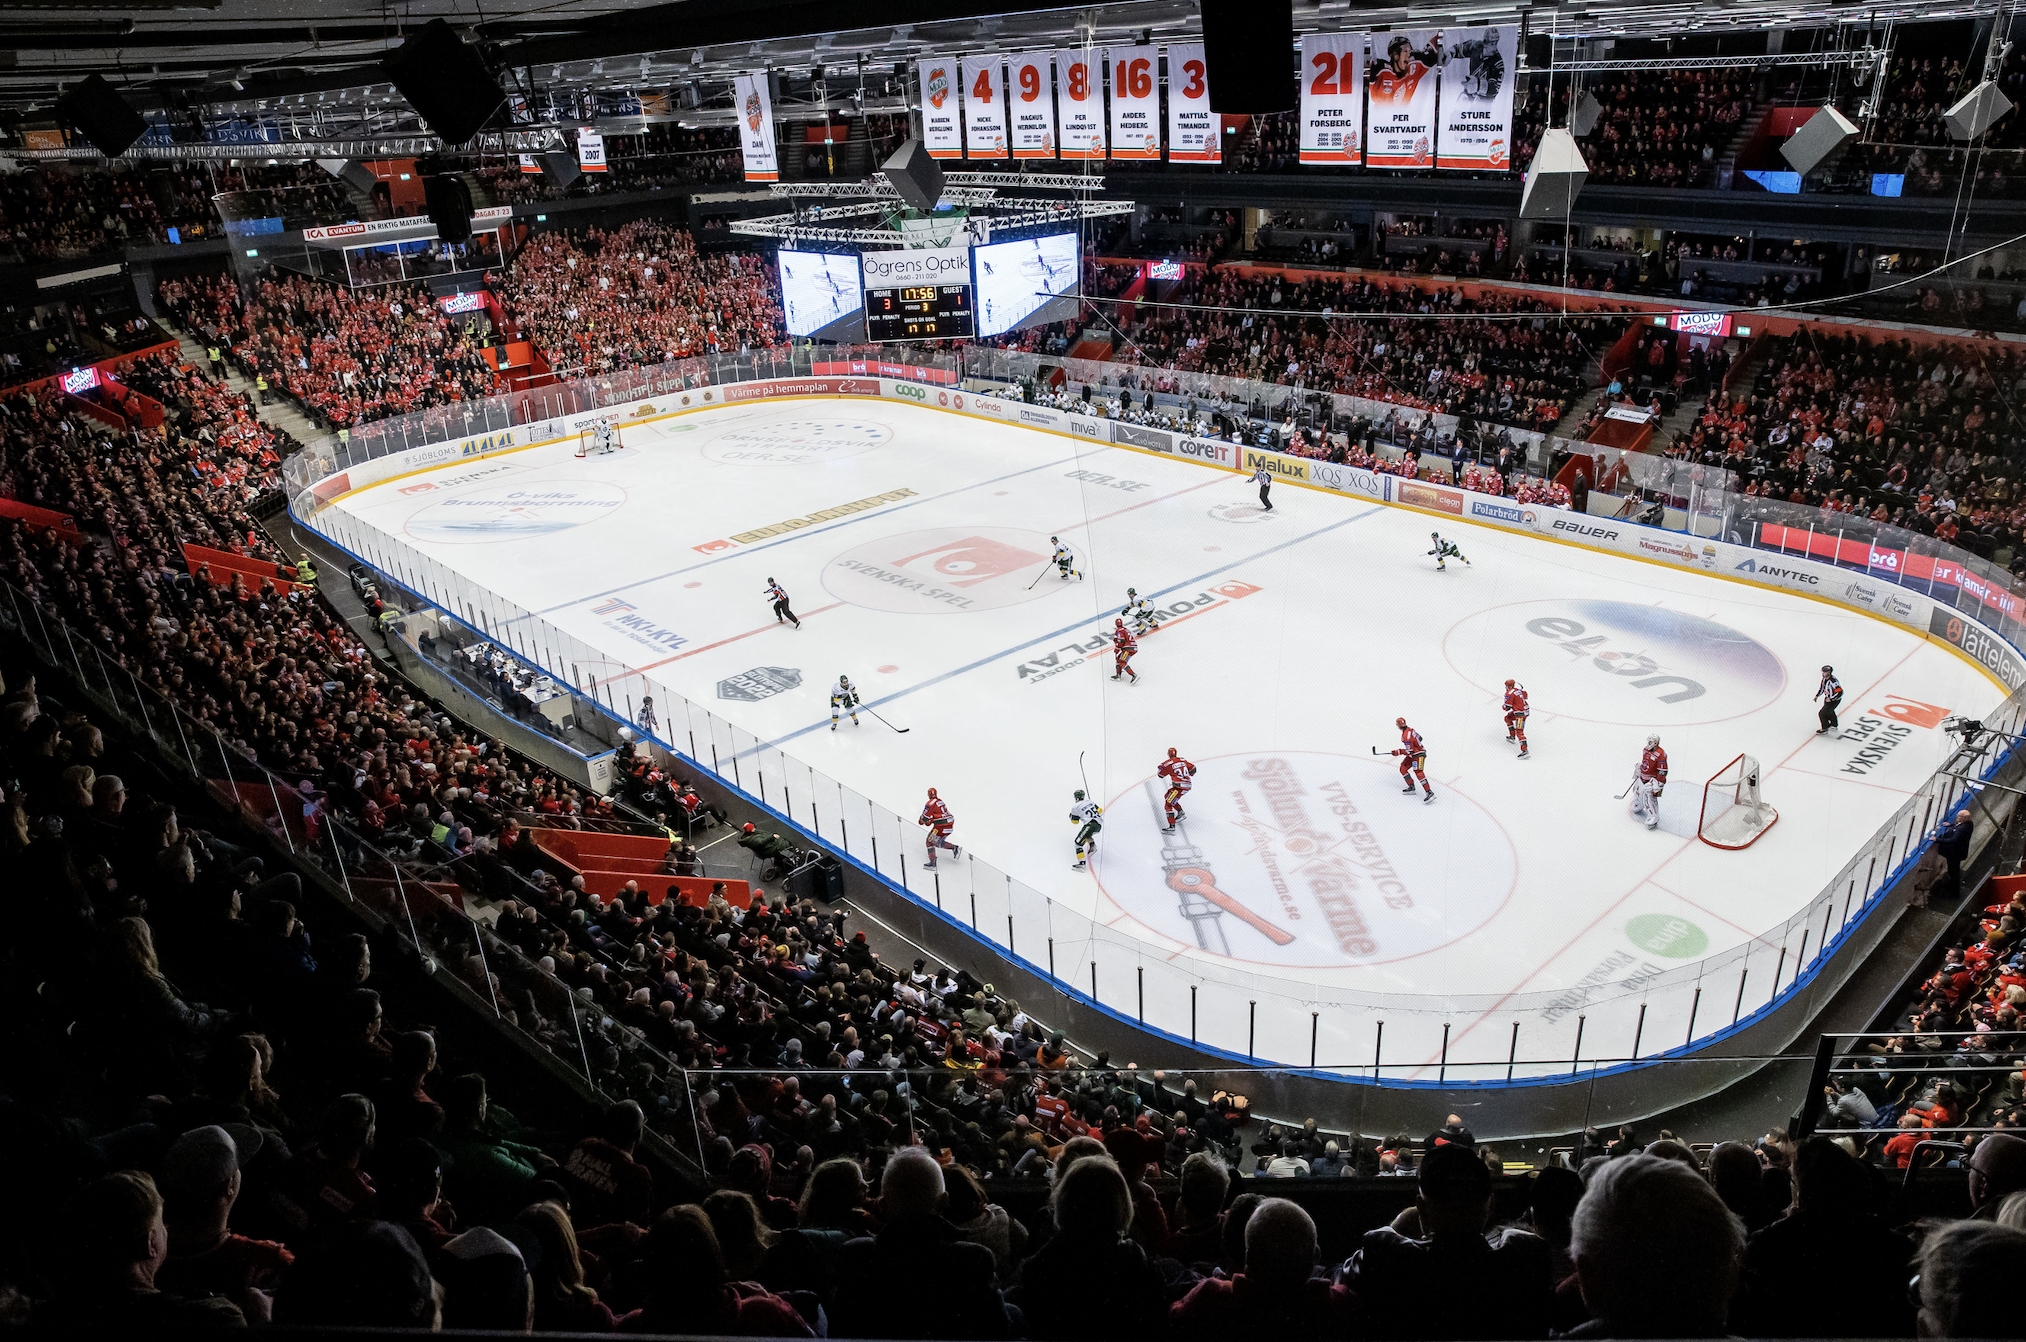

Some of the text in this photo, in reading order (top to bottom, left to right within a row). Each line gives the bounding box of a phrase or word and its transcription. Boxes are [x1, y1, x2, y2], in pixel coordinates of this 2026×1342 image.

[1116, 58, 1152, 98] 16
[1182, 59, 1205, 99] 3
[1310, 52, 1353, 95] 21
[973, 69, 993, 104] 4
[1019, 64, 1040, 102] 9
[1068, 63, 1090, 101] 8
[1318, 109, 1343, 117] PETER
[1392, 114, 1409, 122] PER
[1460, 111, 1491, 119] STURE
[1177, 122, 1210, 130] TIMANDER
[1310, 119, 1351, 128] FORSBERG
[1373, 125, 1427, 133] SVARTVADET
[1448, 123, 1503, 132] ANDERSSON
[585, 150, 600, 160] 2007
[306, 229, 325, 239] ICA
[328, 225, 364, 236] KVANTUM
[377, 221, 398, 230] RIKTIG
[475, 209, 495, 218] DAGAR
[496, 208, 510, 216] 7-23
[864, 255, 968, 277] Ögrens Optik
[1153, 264, 1178, 274] MODO
[873, 289, 892, 298] HOME
[905, 287, 935, 300] 17:56
[942, 286, 963, 294] GUEST
[447, 294, 475, 310] MODO
[883, 298, 892, 310] 3
[922, 302, 929, 312] 3
[957, 295, 962, 305] 1
[1680, 313, 1721, 326] MODO
[908, 323, 936, 333] 17 17
[66, 368, 91, 388] MODO
[730, 382, 829, 398] Värme på hemmaplan
[895, 384, 926, 401] coop
[1071, 422, 1096, 436] miva
[735, 442, 838, 452] AIRPORT
[412, 446, 457, 463] SJÖBLOMS
[721, 451, 811, 463] OER.SE
[1247, 452, 1304, 479] Malux
[1064, 469, 1151, 492] OER.SE
[1313, 465, 1342, 487] XQS
[1349, 472, 1381, 496] XQS
[507, 491, 579, 499] Ö-viks
[441, 499, 621, 508] Brunnsborrning
[1475, 503, 1519, 521] Polarbröd
[1639, 541, 1699, 559] Magnussons
[1758, 565, 1819, 585] ANYTEC
[837, 559, 976, 609] SVENSKA SPEL
[1854, 584, 1877, 598] Svensk
[1856, 593, 1874, 604] Cater
[1892, 597, 1913, 611] Svensk
[1893, 605, 1910, 617] Cater
[1962, 624, 2026, 691] lättelem
[1030, 657, 1086, 684] ODDSET
[728, 674, 776, 699] 2022
[1836, 716, 1883, 743] SPEL
[1840, 723, 1913, 775] SVENSKA
[1173, 767, 1190, 779] 34
